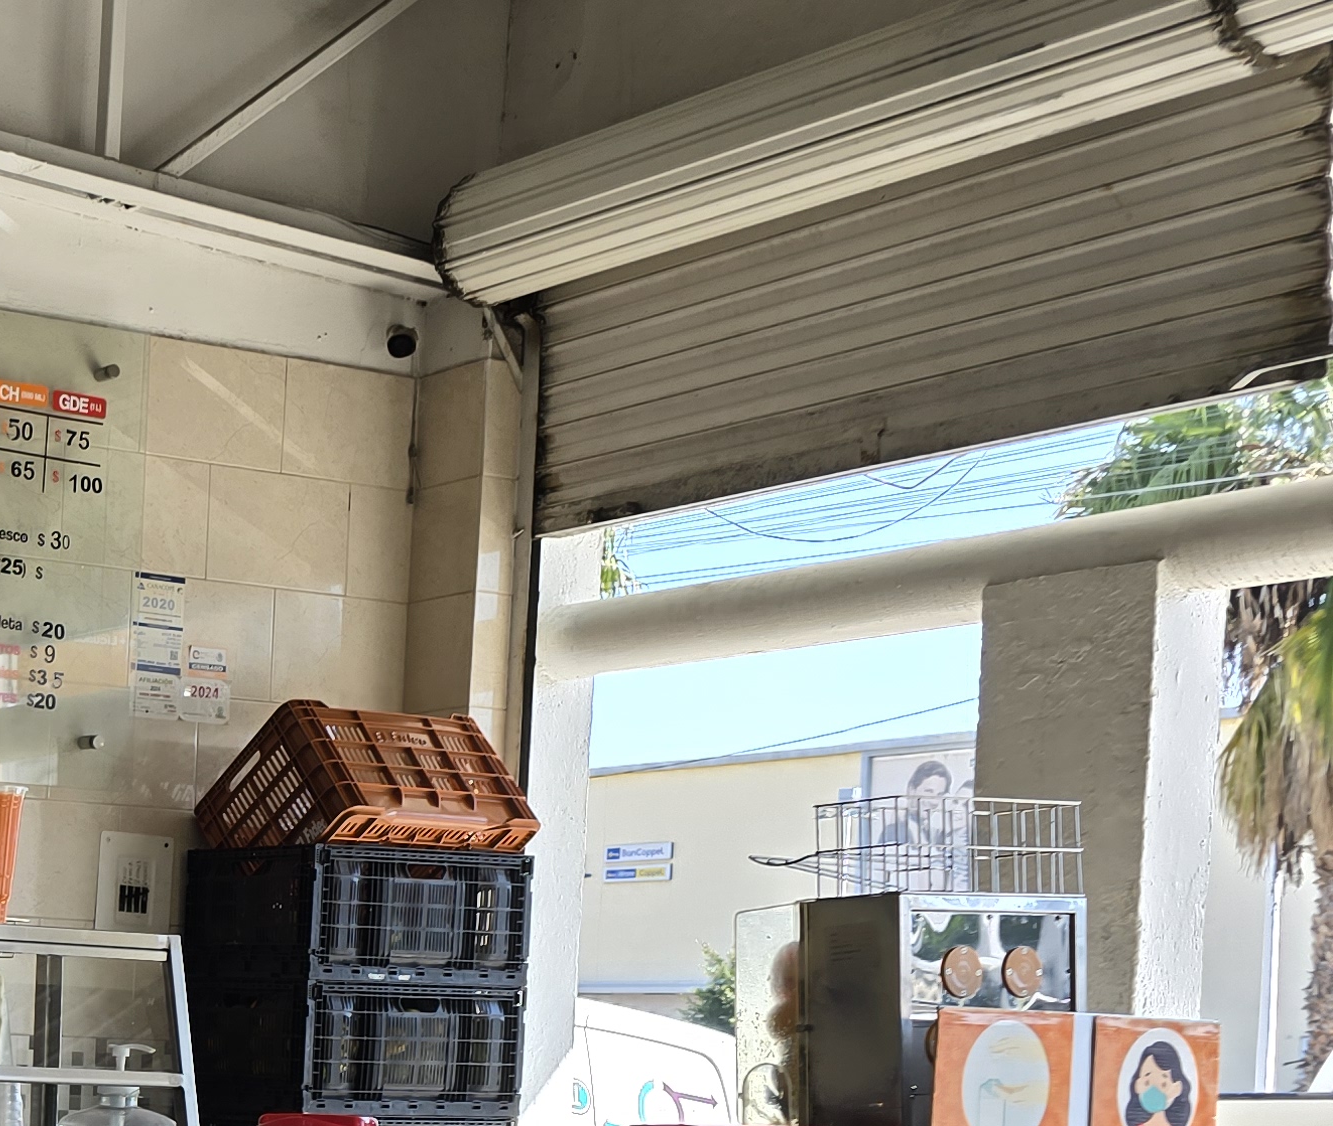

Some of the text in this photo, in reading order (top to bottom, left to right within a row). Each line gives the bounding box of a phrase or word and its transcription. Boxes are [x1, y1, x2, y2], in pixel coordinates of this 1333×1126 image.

[58, 393, 89, 414] GDE
[142, 595, 175, 611] 2020
[622, 847, 664, 858] BanCoppel
